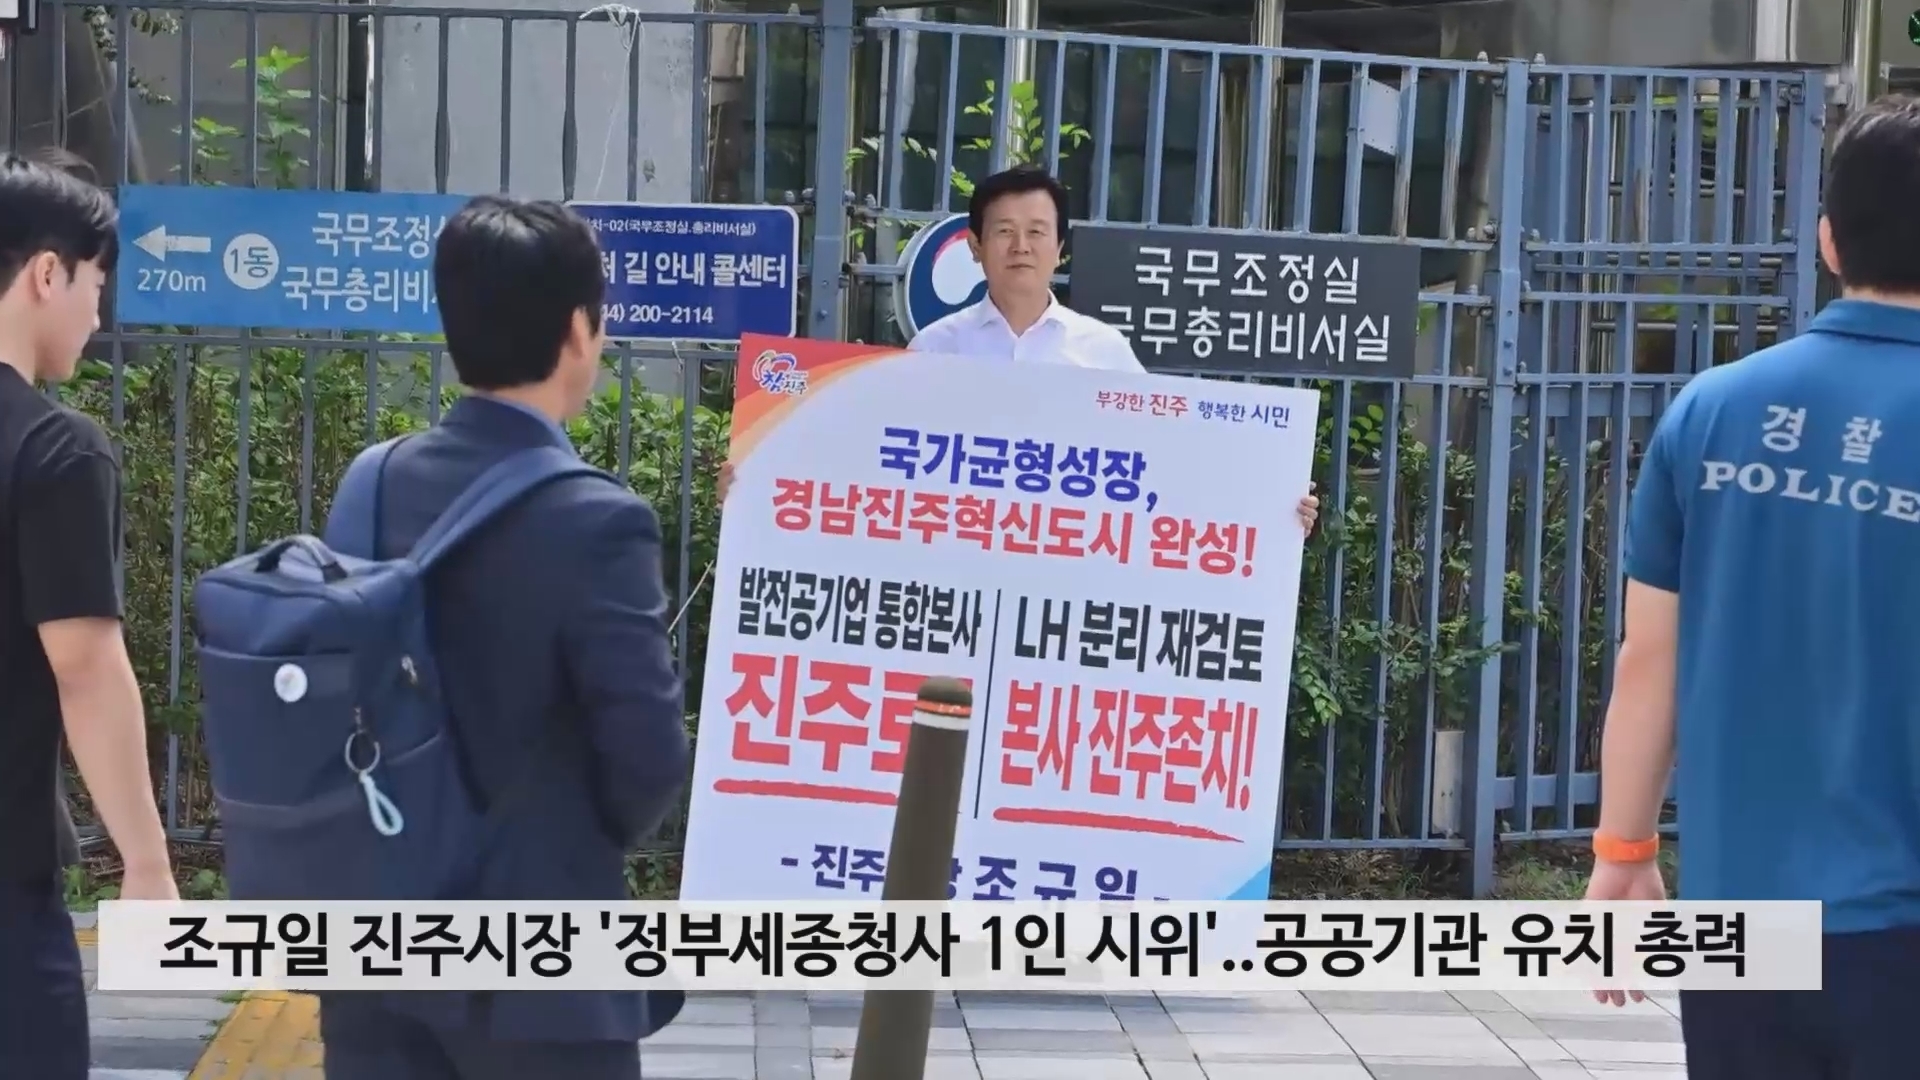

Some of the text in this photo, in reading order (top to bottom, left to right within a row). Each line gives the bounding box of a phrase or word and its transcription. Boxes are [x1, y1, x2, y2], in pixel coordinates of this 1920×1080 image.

[137, 268, 207, 293] 270m
[229, 246, 274, 280] 1동
[281, 265, 437, 314] 국무총리비
[624, 250, 648, 285] 길
[655, 251, 706, 287] 안내
[711, 253, 786, 289] 콜센터
[1135, 246, 1359, 305] 국무조정실
[629, 304, 714, 324] 200-2114
[1096, 390, 1291, 429] 부강한 진주 행복한 시민
[879, 426, 1159, 513] 국가균형성장,
[1700, 460, 1920, 523] POLICE
[771, 478, 1256, 577] 경남진주혁신도시 완성!
[738, 566, 982, 658] 발전공기업 통합본사
[1014, 595, 1265, 683] LH 분리 재검토
[1001, 679, 1258, 811] 본사 진주존치!
